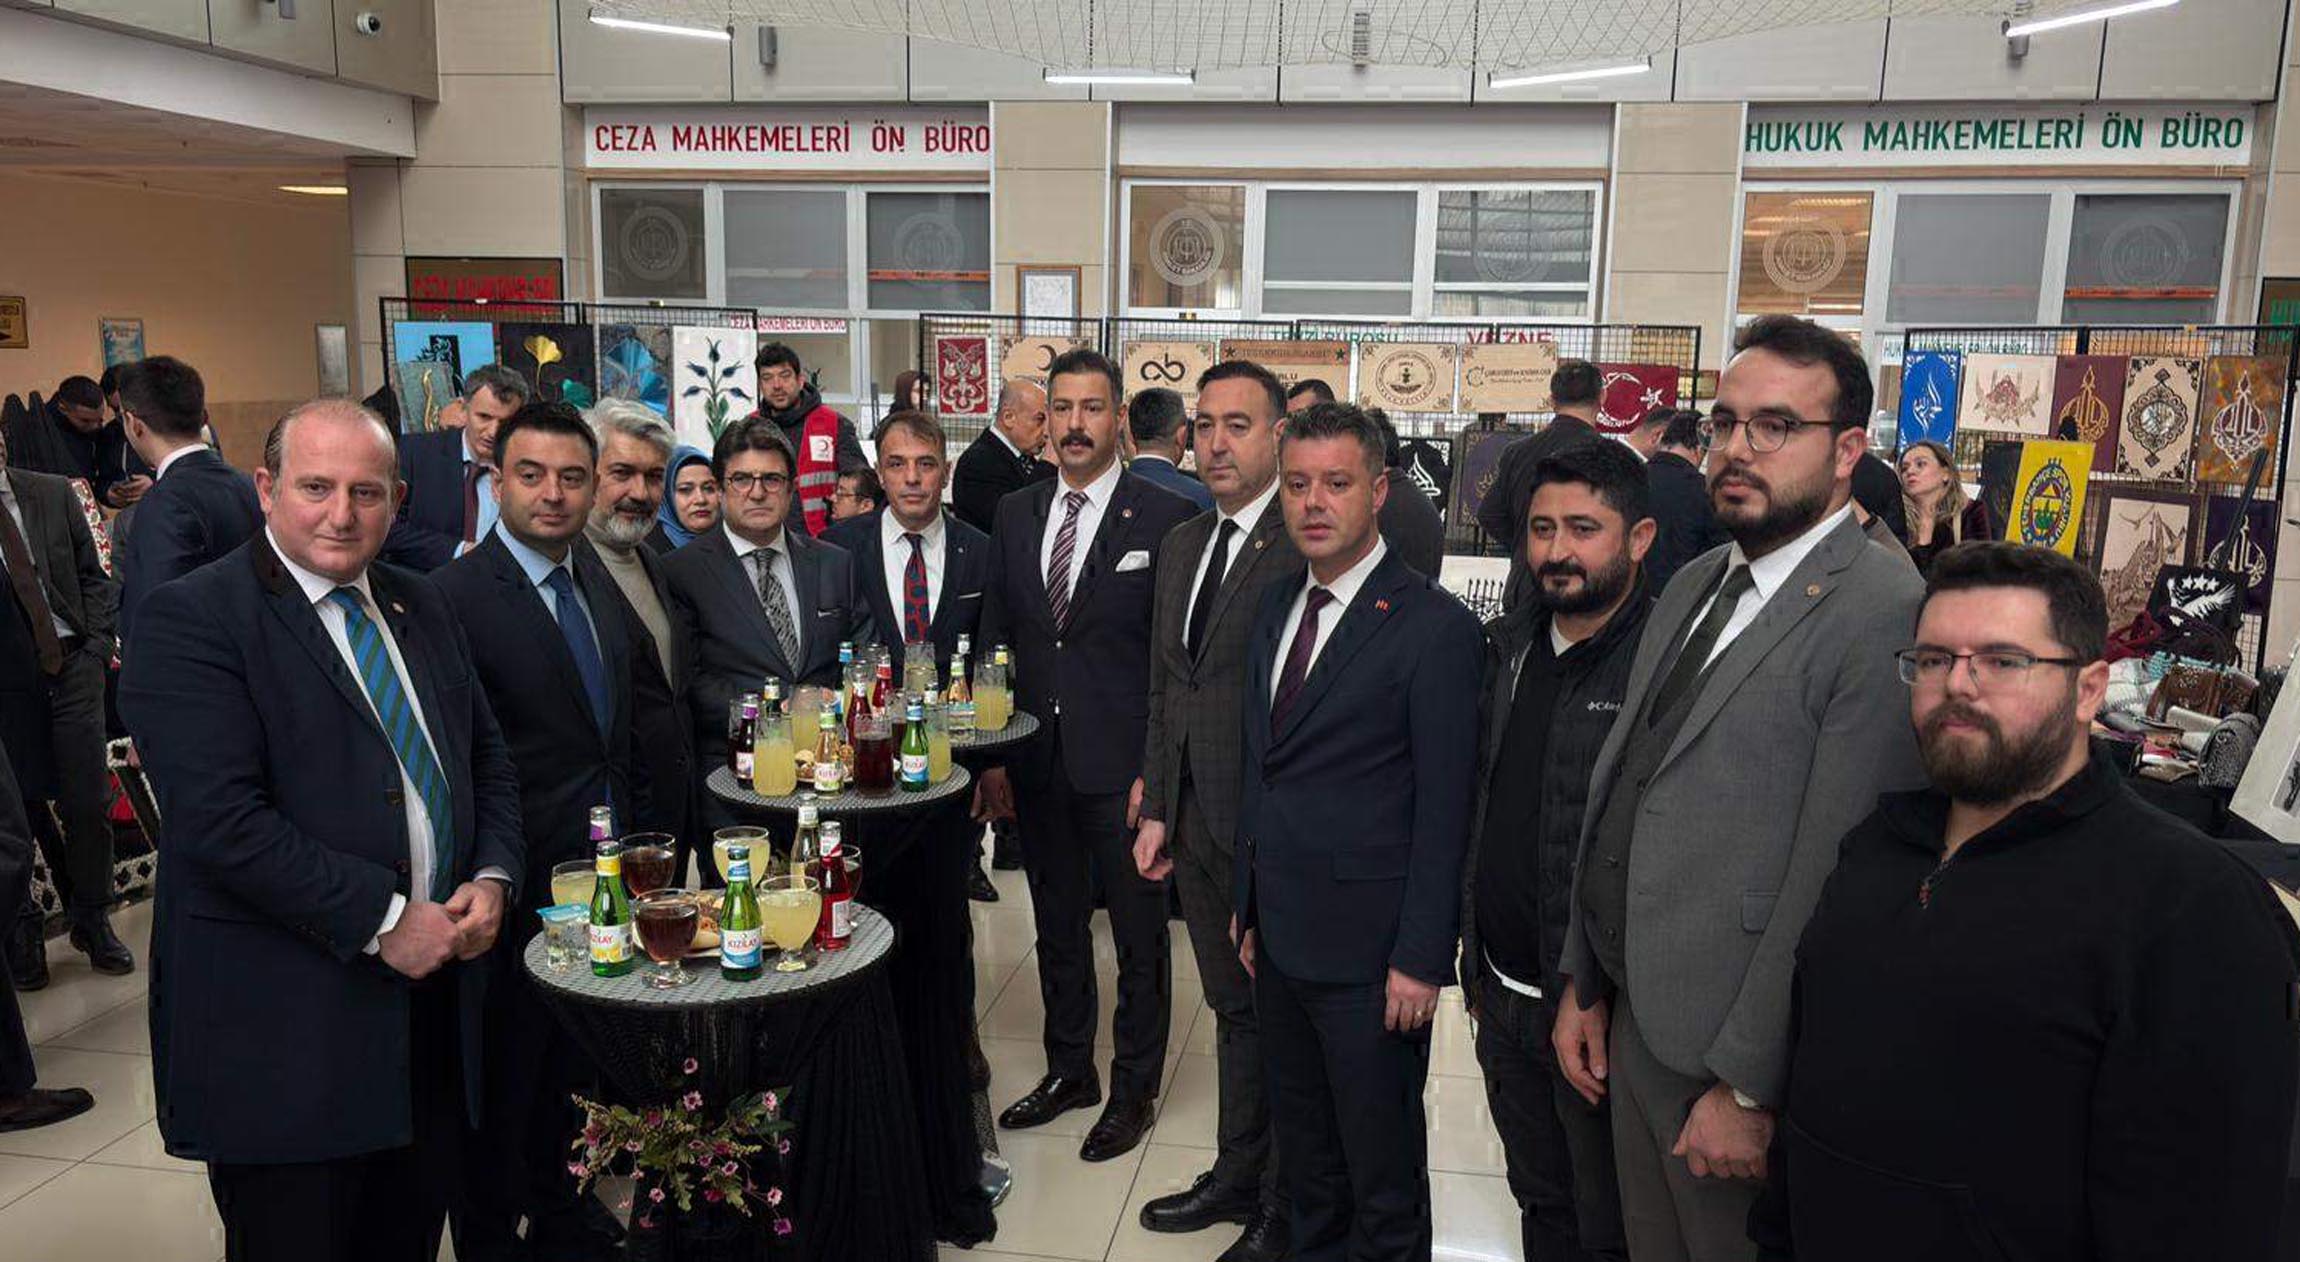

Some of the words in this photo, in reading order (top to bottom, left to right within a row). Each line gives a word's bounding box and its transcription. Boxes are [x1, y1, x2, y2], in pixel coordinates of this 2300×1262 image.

[595, 125, 657, 152] CEZA
[673, 120, 850, 152] MAHKEMELERİ
[872, 120, 905, 153] ÖN
[925, 120, 990, 153] BÜRO
[1746, 120, 1844, 153] HUKUK
[1863, 113, 2085, 152] MAHKEMELERİ
[2102, 112, 2143, 149] ÖN
[2161, 112, 2245, 149] BÜRO
[757, 315, 810, 330] AHKEMELERİ
